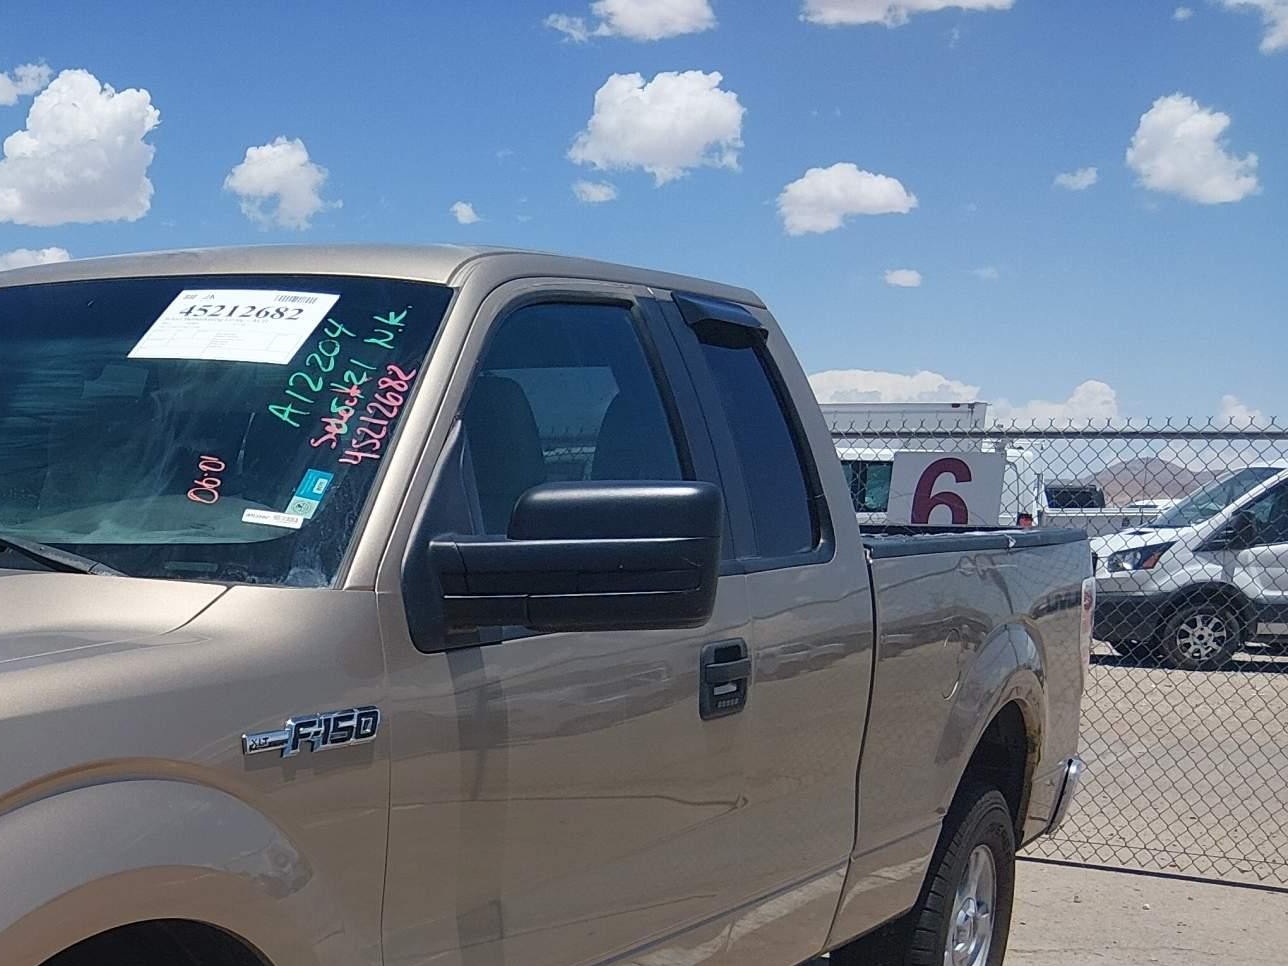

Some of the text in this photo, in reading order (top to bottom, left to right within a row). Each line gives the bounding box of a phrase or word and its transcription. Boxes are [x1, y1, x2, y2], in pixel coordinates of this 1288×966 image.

[179, 304, 306, 321] 45212682
[267, 318, 357, 428] A12204
[338, 364, 417, 465] 45212682
[910, 457, 972, 525] 6
